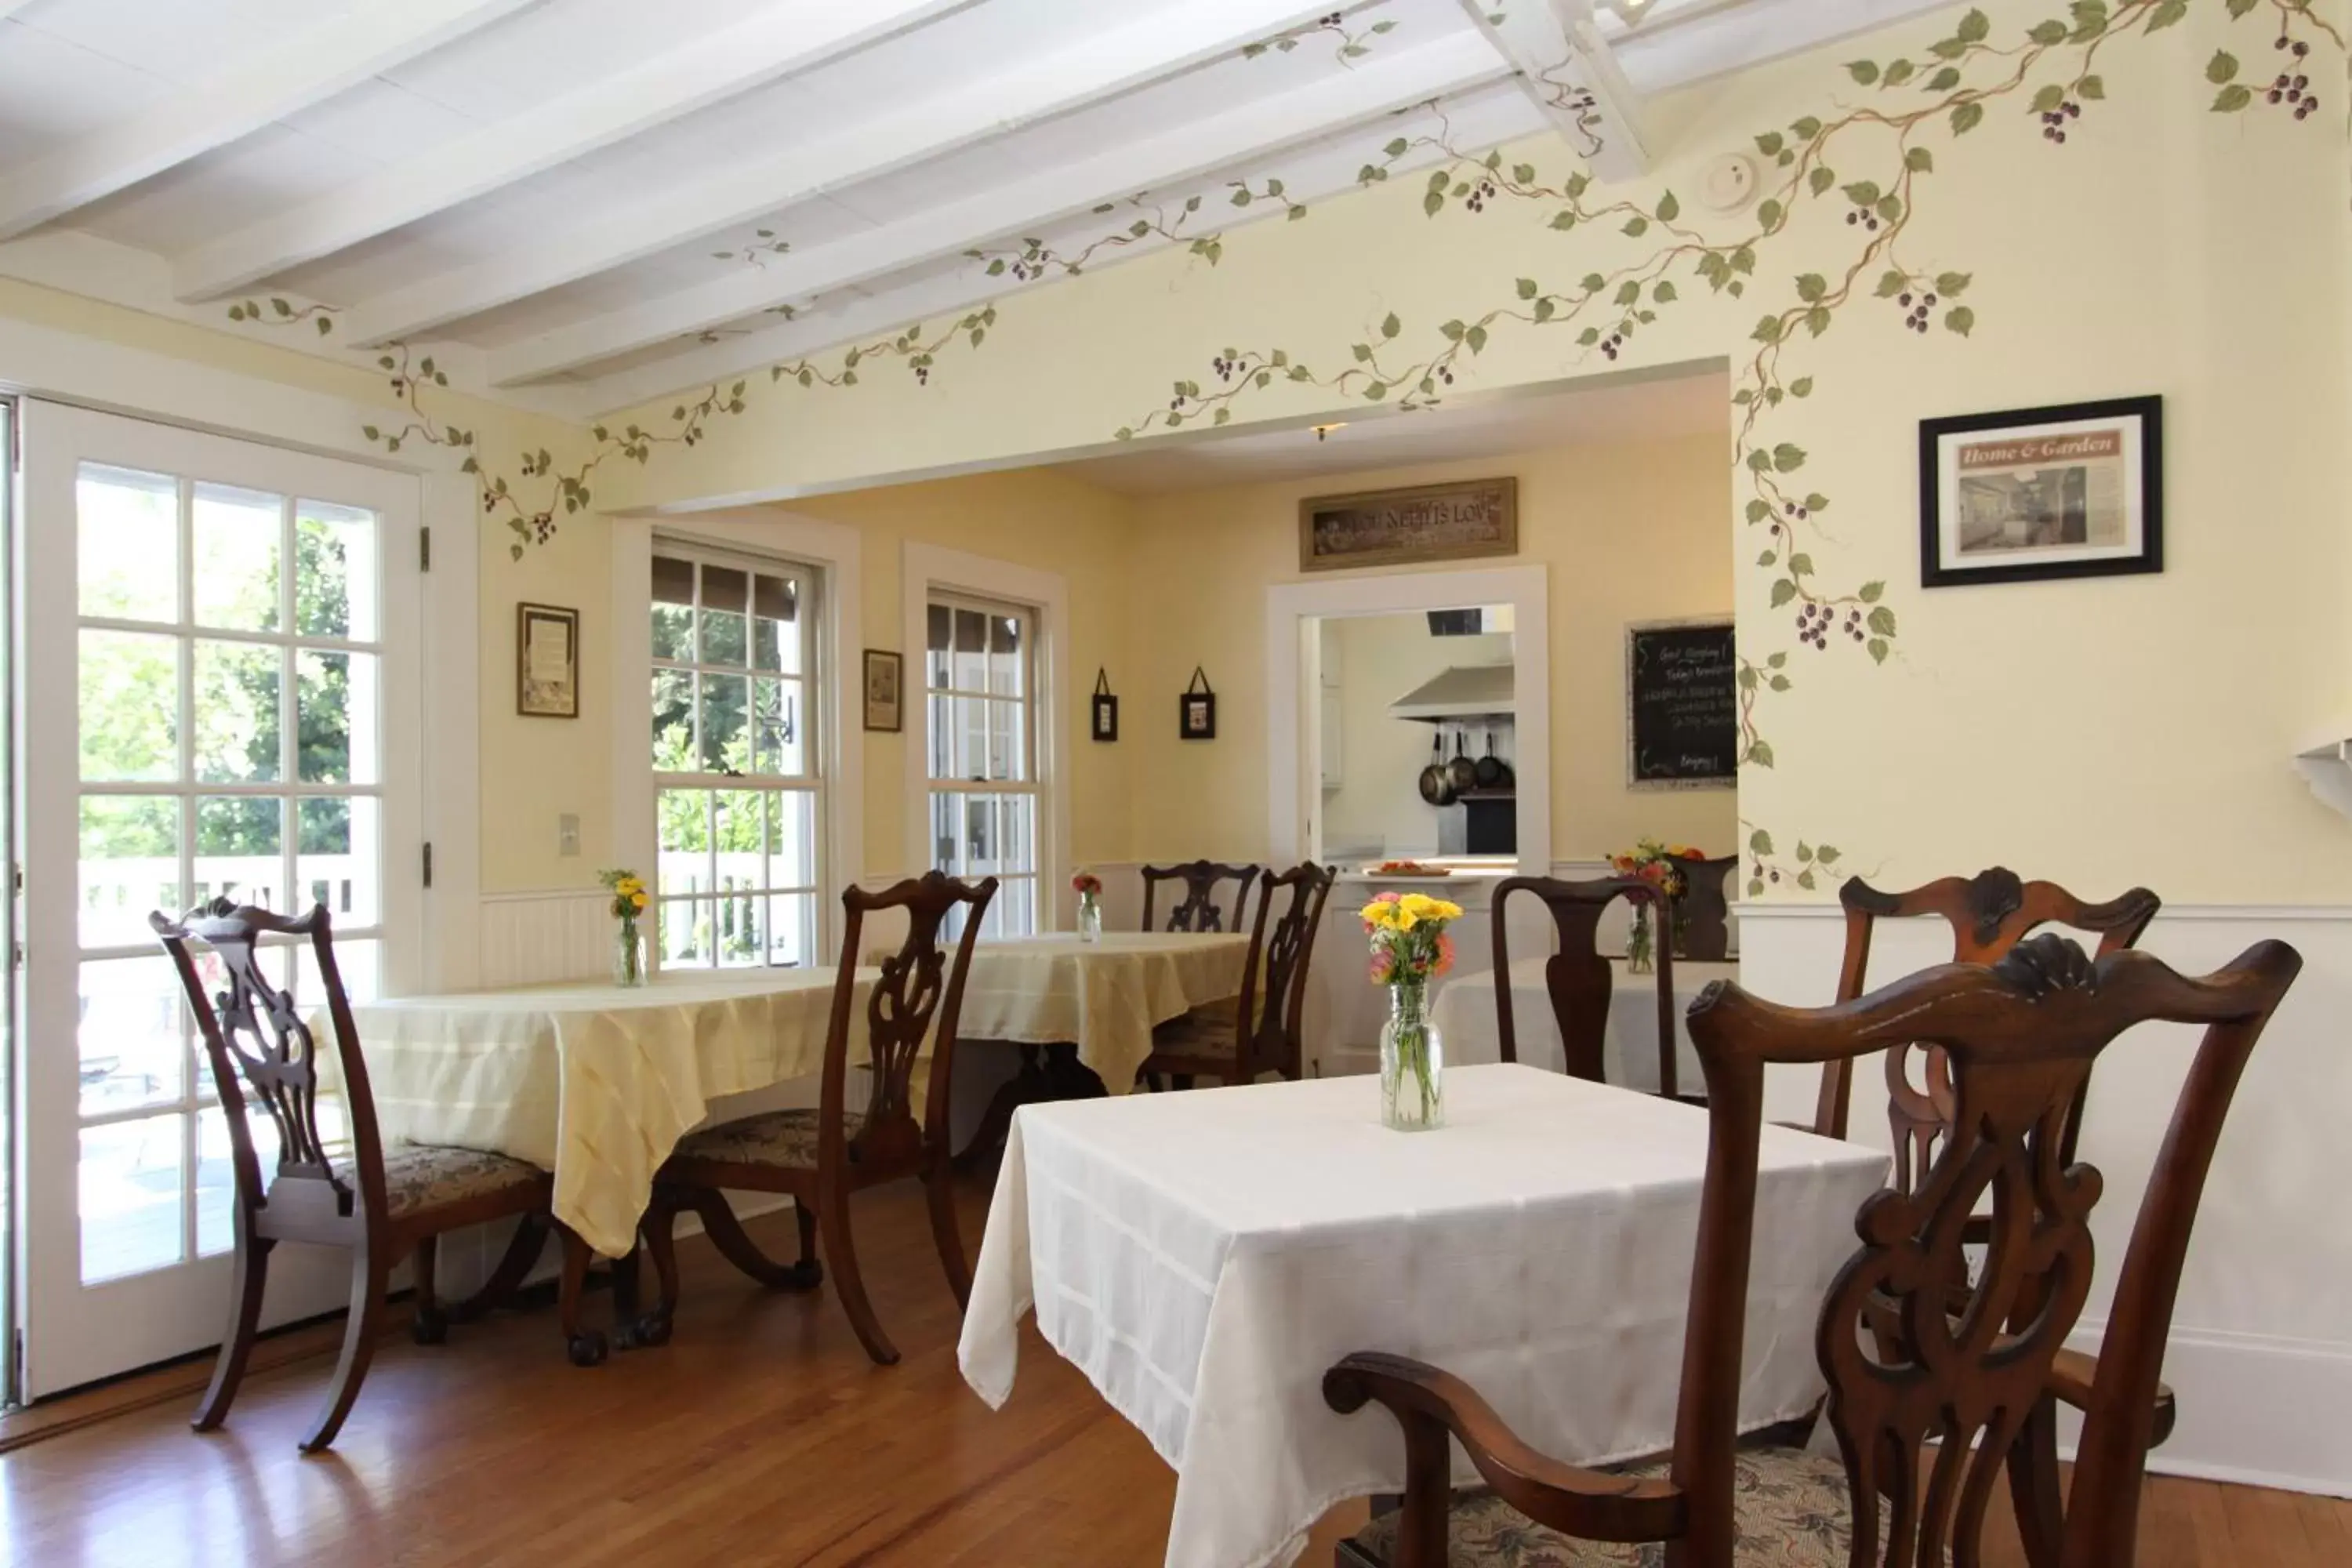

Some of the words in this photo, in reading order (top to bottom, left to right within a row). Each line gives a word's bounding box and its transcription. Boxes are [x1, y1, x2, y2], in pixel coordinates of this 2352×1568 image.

[1963, 447, 2017, 464] Home
[2020, 441, 2036, 458] &
[2041, 437, 2113, 456] Garden
[1433, 503, 1449, 524] IS
